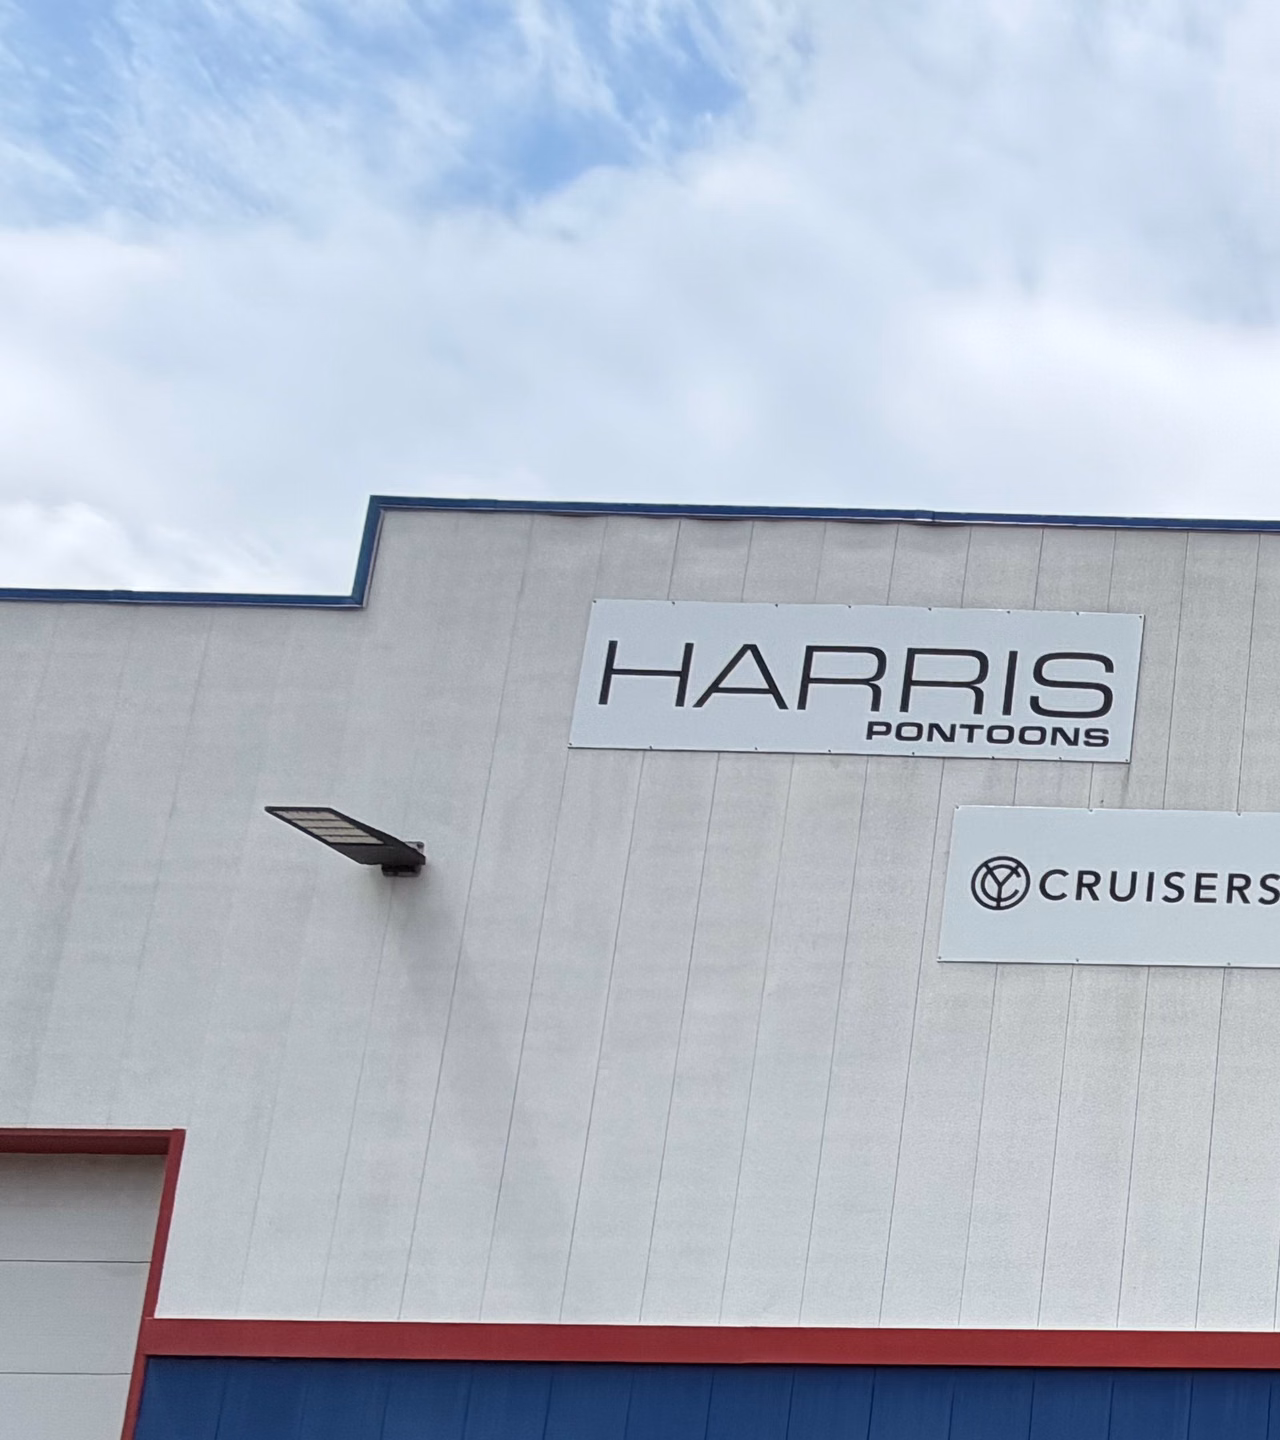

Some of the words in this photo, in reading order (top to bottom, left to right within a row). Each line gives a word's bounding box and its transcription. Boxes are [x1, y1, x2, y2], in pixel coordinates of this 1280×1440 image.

[598, 640, 1114, 718] HARRIS
[865, 720, 1110, 748] PONTOONS
[1038, 868, 1280, 906] CRUISERS
